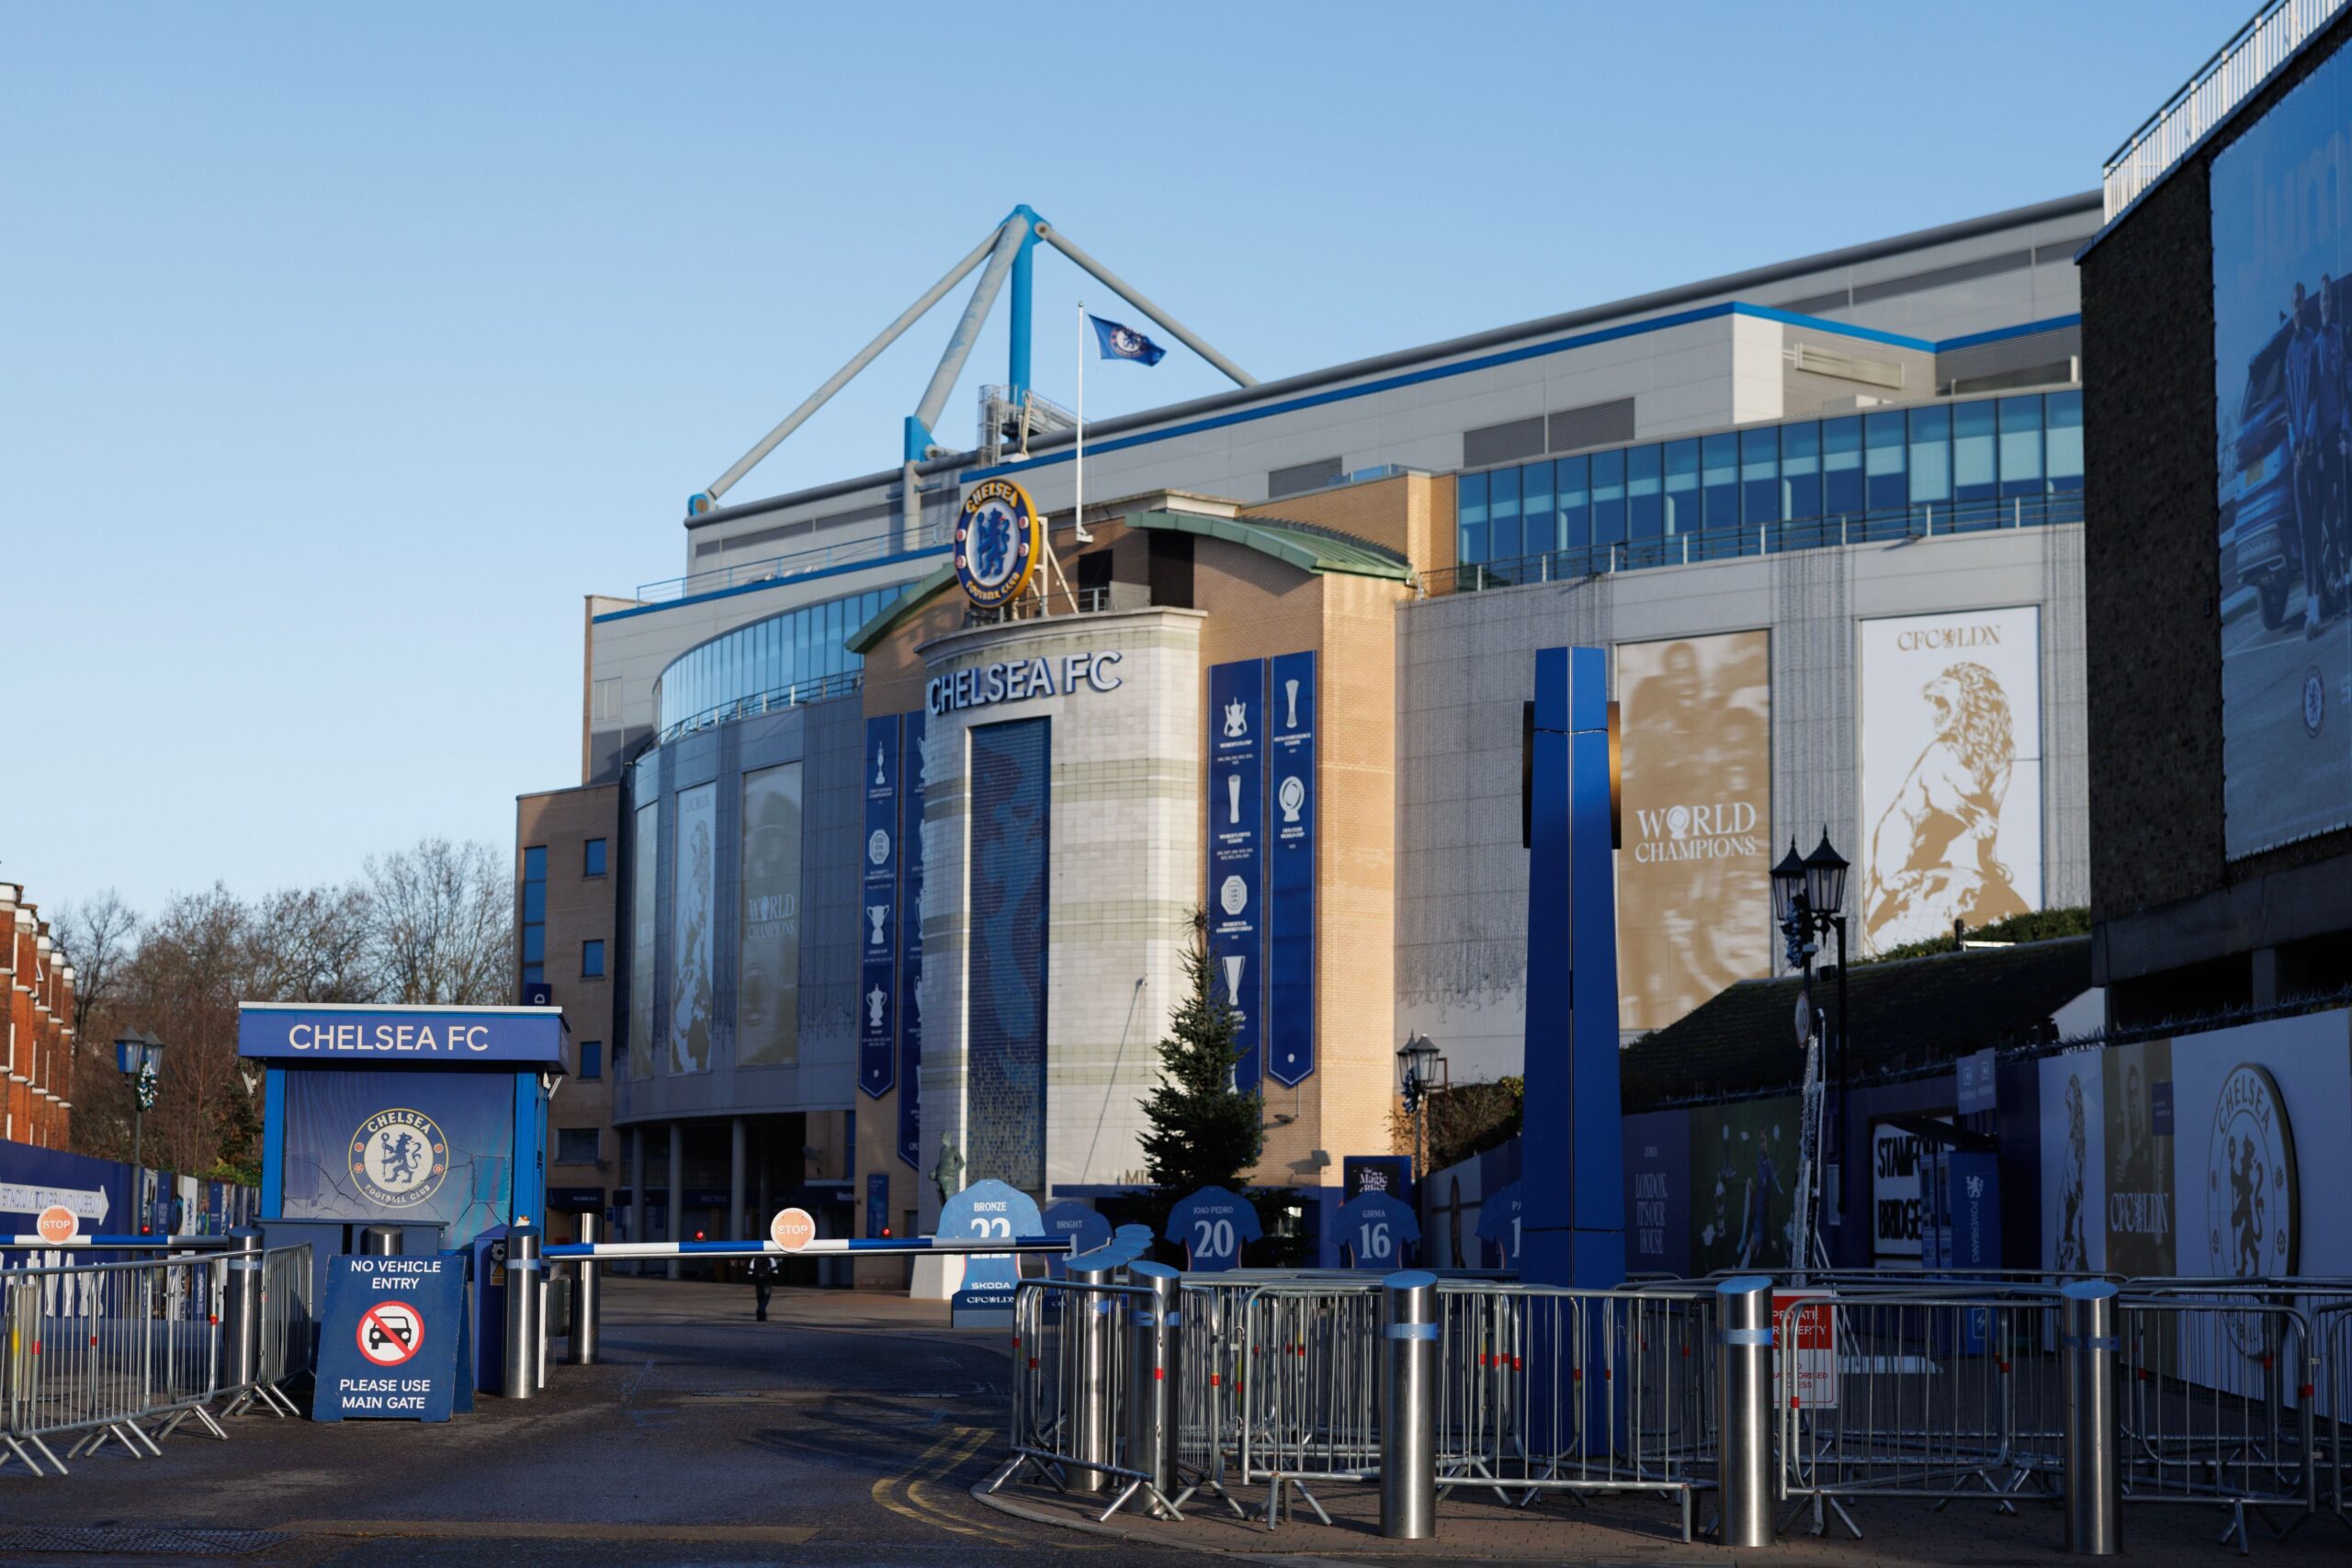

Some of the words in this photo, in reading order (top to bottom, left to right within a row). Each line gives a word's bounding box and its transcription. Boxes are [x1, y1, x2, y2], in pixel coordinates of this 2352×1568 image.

[966, 482, 1017, 513] CHELSEA
[1001, 571, 1021, 594] CLUB
[1897, 629, 1941, 651] CFC
[1957, 625, 2001, 648] LDN
[928, 657, 1055, 716] CHELSEA
[1062, 650, 1123, 694] FC
[1635, 801, 1757, 840] WORLD
[1634, 835, 1757, 863] CHAMPIONS
[748, 893, 795, 921] WORLD
[288, 1023, 437, 1052] CHELSEA
[447, 1025, 489, 1051] FC
[2219, 1074, 2271, 1134] CHELSEA
[368, 1111, 431, 1134] CHELSEA
[1360, 1172, 1388, 1188] Magic
[364, 1183, 407, 1203] FOOTBALL
[410, 1184, 431, 1201] CLUB
[973, 1201, 1007, 1213] BRONZE
[1210, 1205, 1234, 1214] PEDRO
[1362, 1209, 1386, 1219] GIRMA
[1878, 1198, 1923, 1240] BRIDGE
[2109, 1191, 2134, 1233] CFC
[2143, 1191, 2169, 1233] LDN
[42, 1220, 71, 1229] STOP
[777, 1224, 808, 1235] STOP
[1057, 1220, 1082, 1229] BRIGHT
[1970, 1201, 1981, 1264] POWERBANKS
[970, 1217, 1011, 1259] 22
[1193, 1219, 1235, 1258] 20
[1359, 1223, 1391, 1259] 16
[350, 1260, 374, 1272] NO
[377, 1259, 442, 1273] VEHICLE
[371, 1276, 420, 1291] ENTRY
[339, 1379, 398, 1393] PLEASE
[401, 1379, 431, 1393] USE
[342, 1396, 382, 1410] MAIN
[385, 1395, 425, 1410] GATE
